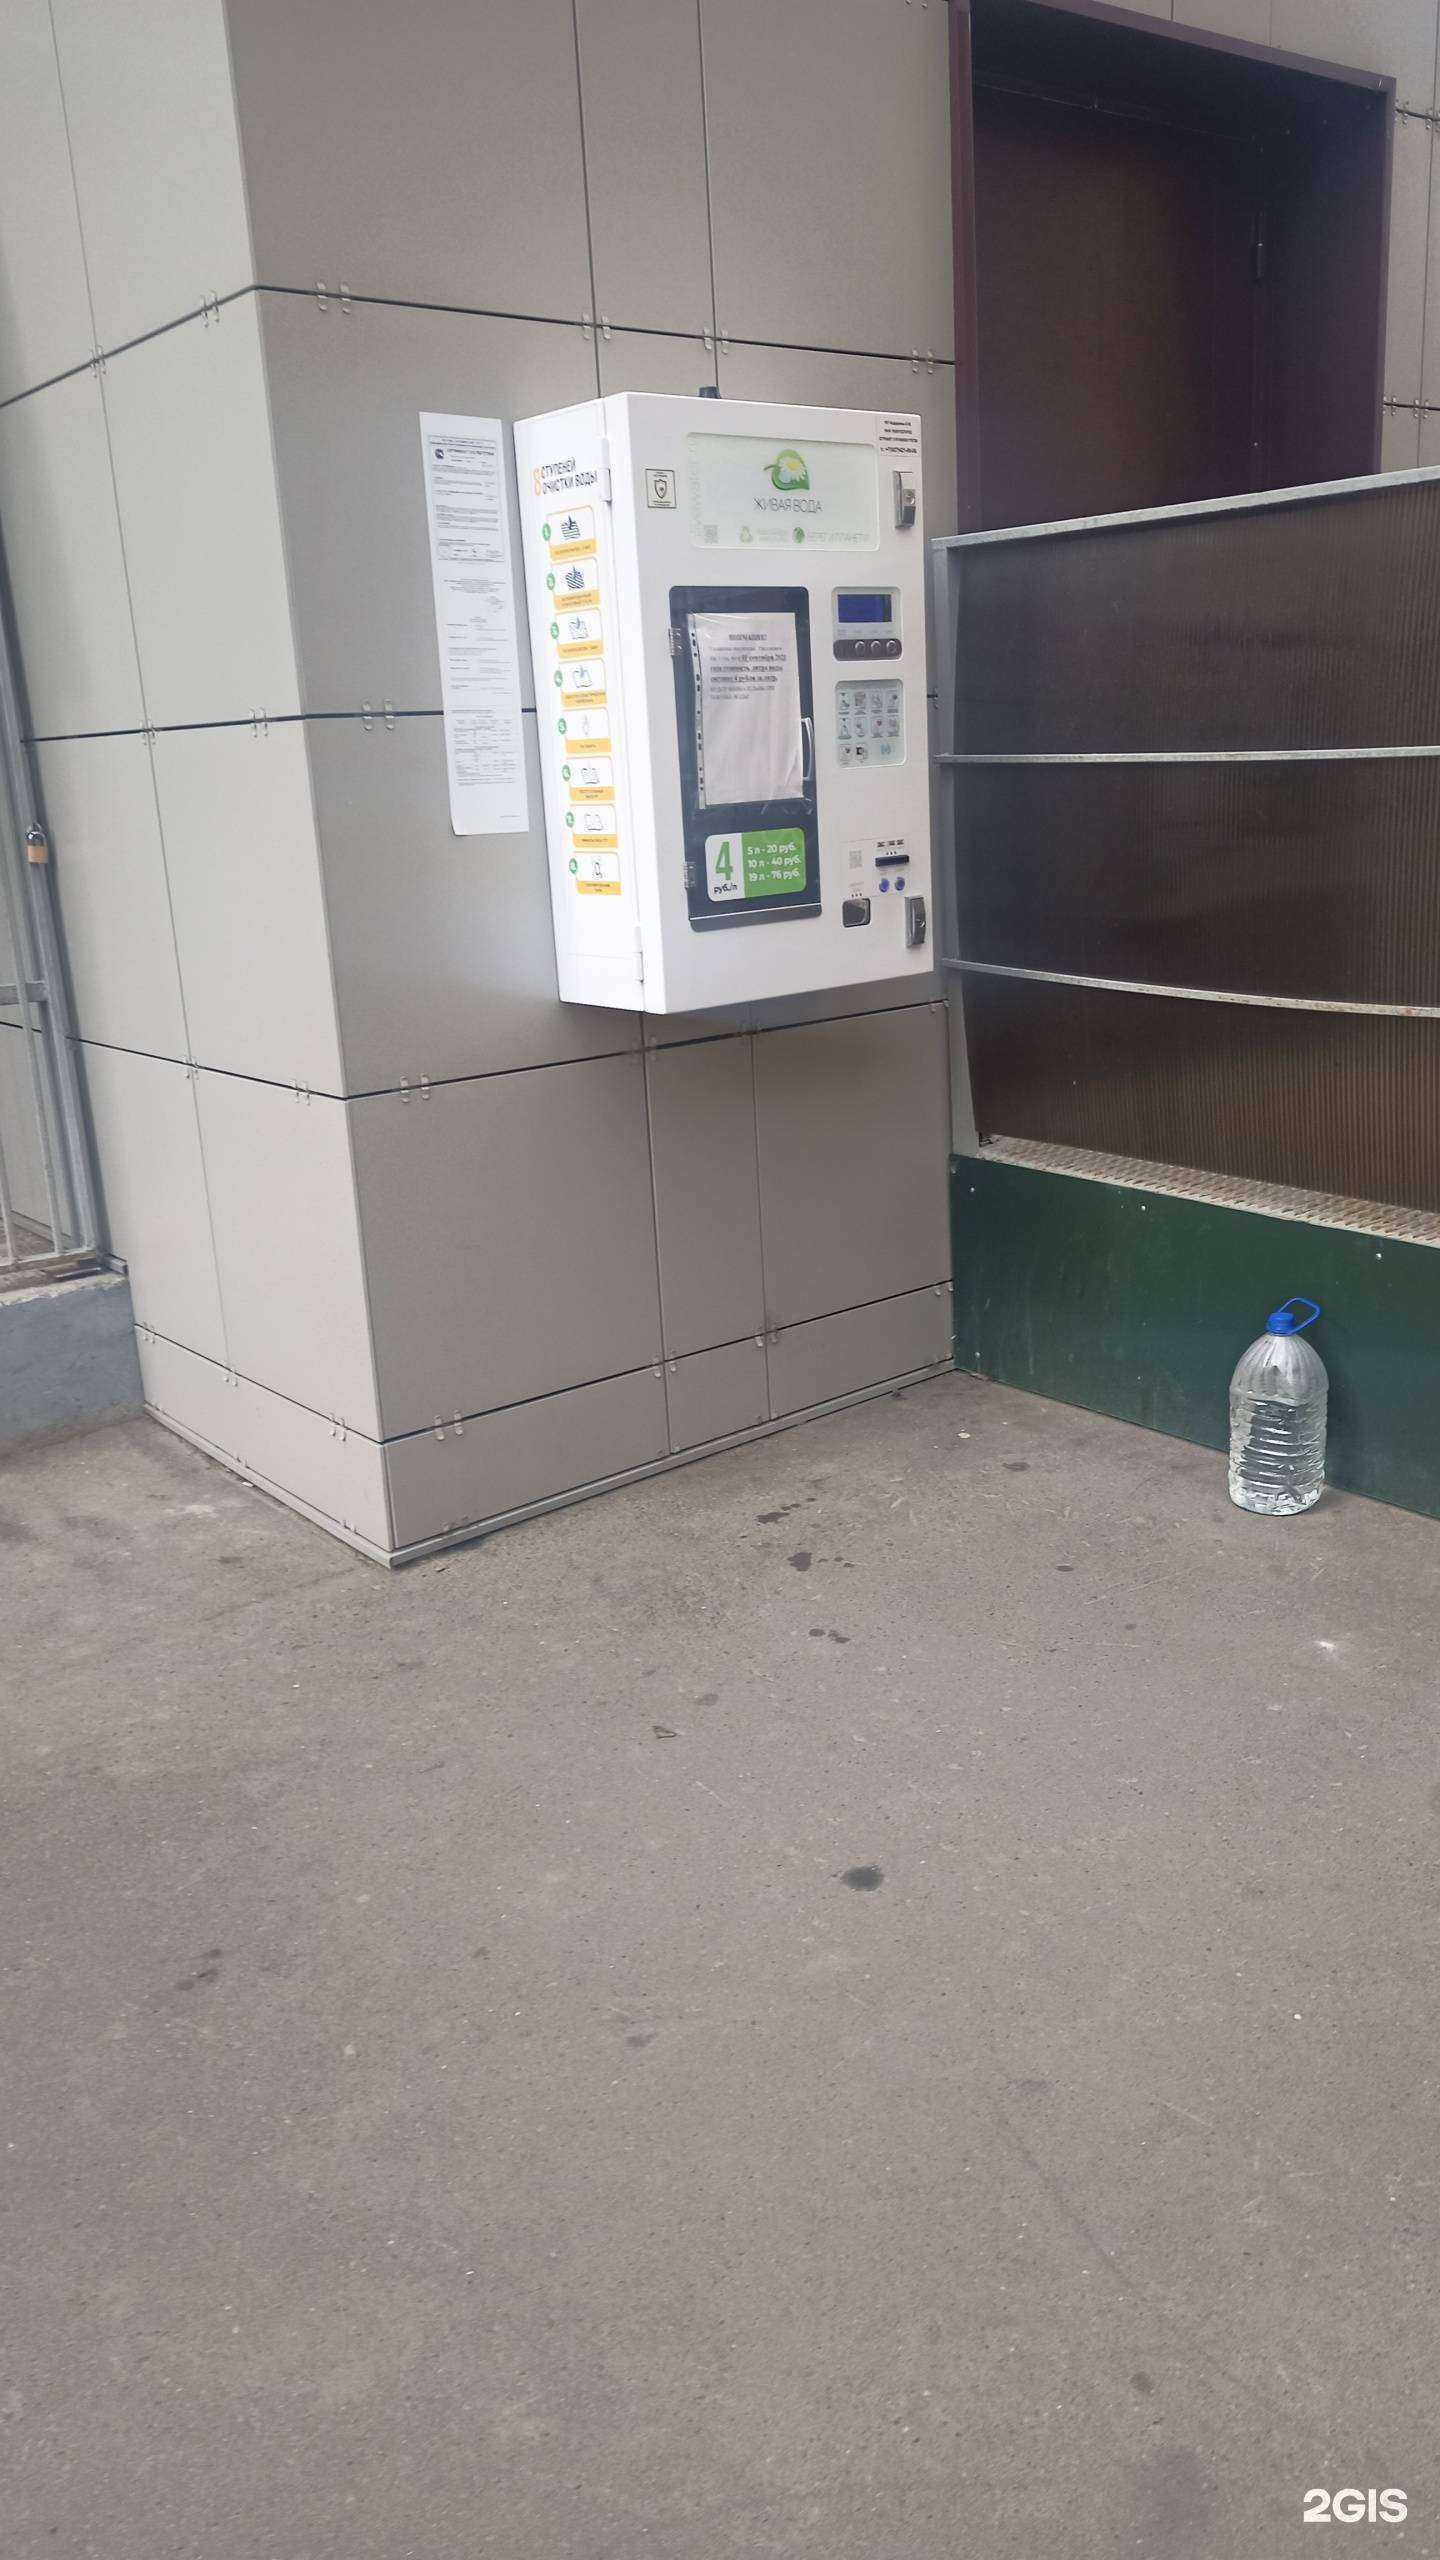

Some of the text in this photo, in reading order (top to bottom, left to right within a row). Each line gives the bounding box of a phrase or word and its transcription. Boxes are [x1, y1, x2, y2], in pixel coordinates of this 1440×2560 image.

[541, 456, 576, 479] СТУПЕНЕЙ
[533, 467, 541, 496] 8
[543, 470, 598, 495] ОЧИСТКИ ВОДЫ
[753, 498, 823, 513] ЖИВАЯ ВОДА
[747, 846, 754, 855] 5
[754, 846, 760, 854] л
[767, 844, 777, 853] 20
[715, 841, 733, 880] 4
[748, 860, 757, 868] 10
[772, 857, 782, 866] 40
[771, 870, 782, 879] 76
